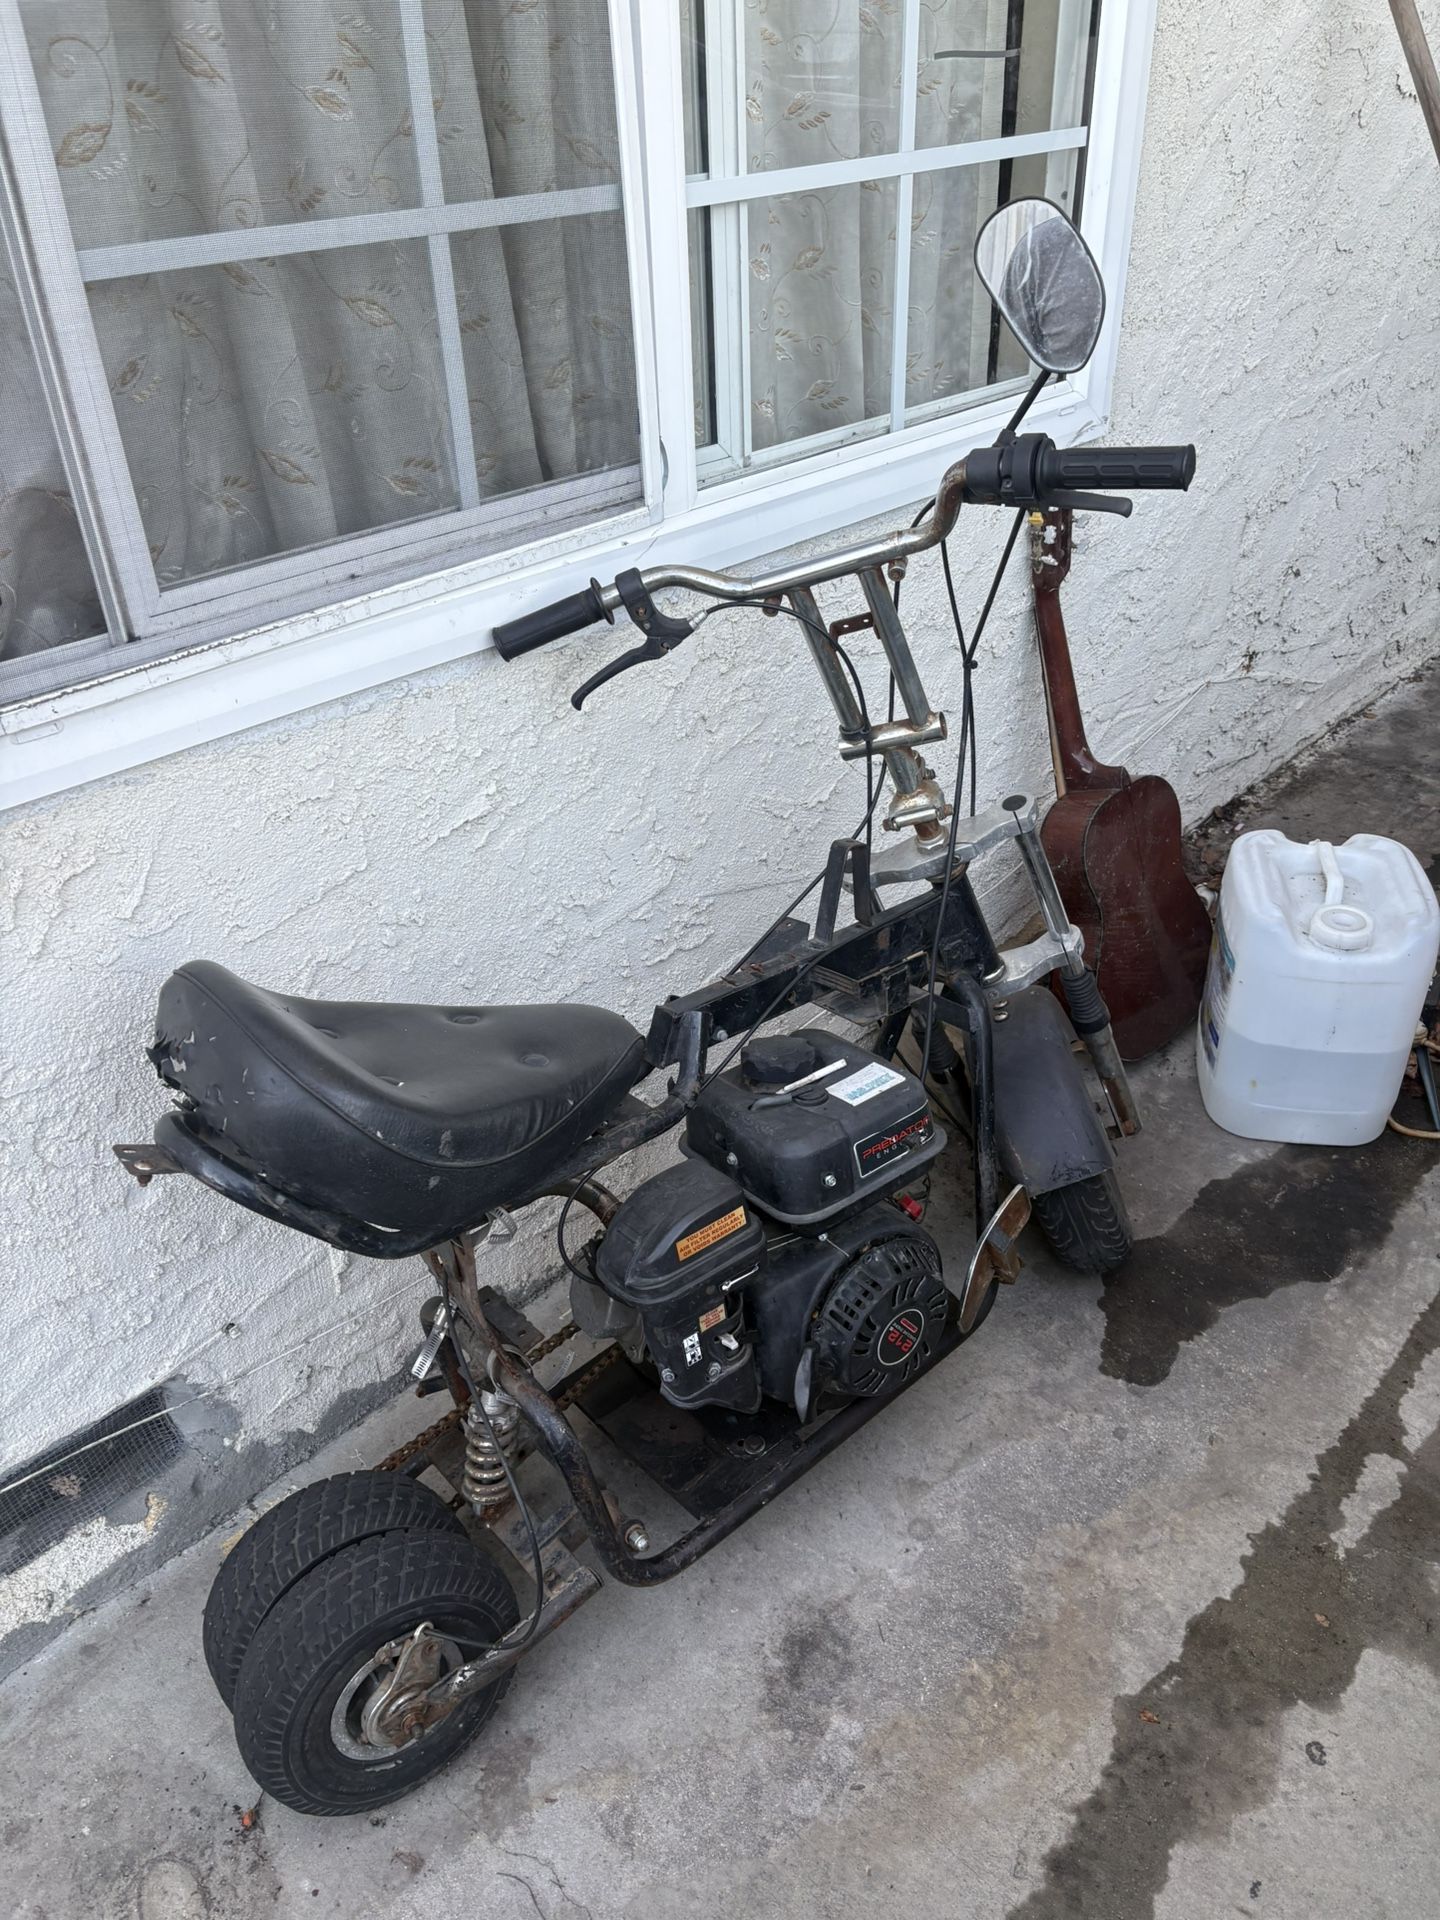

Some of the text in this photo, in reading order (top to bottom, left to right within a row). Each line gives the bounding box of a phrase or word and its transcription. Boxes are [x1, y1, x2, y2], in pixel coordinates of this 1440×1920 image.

[863, 1115, 929, 1160] PREDATOR
[679, 1214, 744, 1253] AIR FILTER REGULARLY
[686, 1212, 736, 1243] YOU MUST CLEAN
[683, 1249, 693, 1257] OR
[693, 1240, 711, 1252] VOIDS
[887, 1329, 914, 1353] 212
